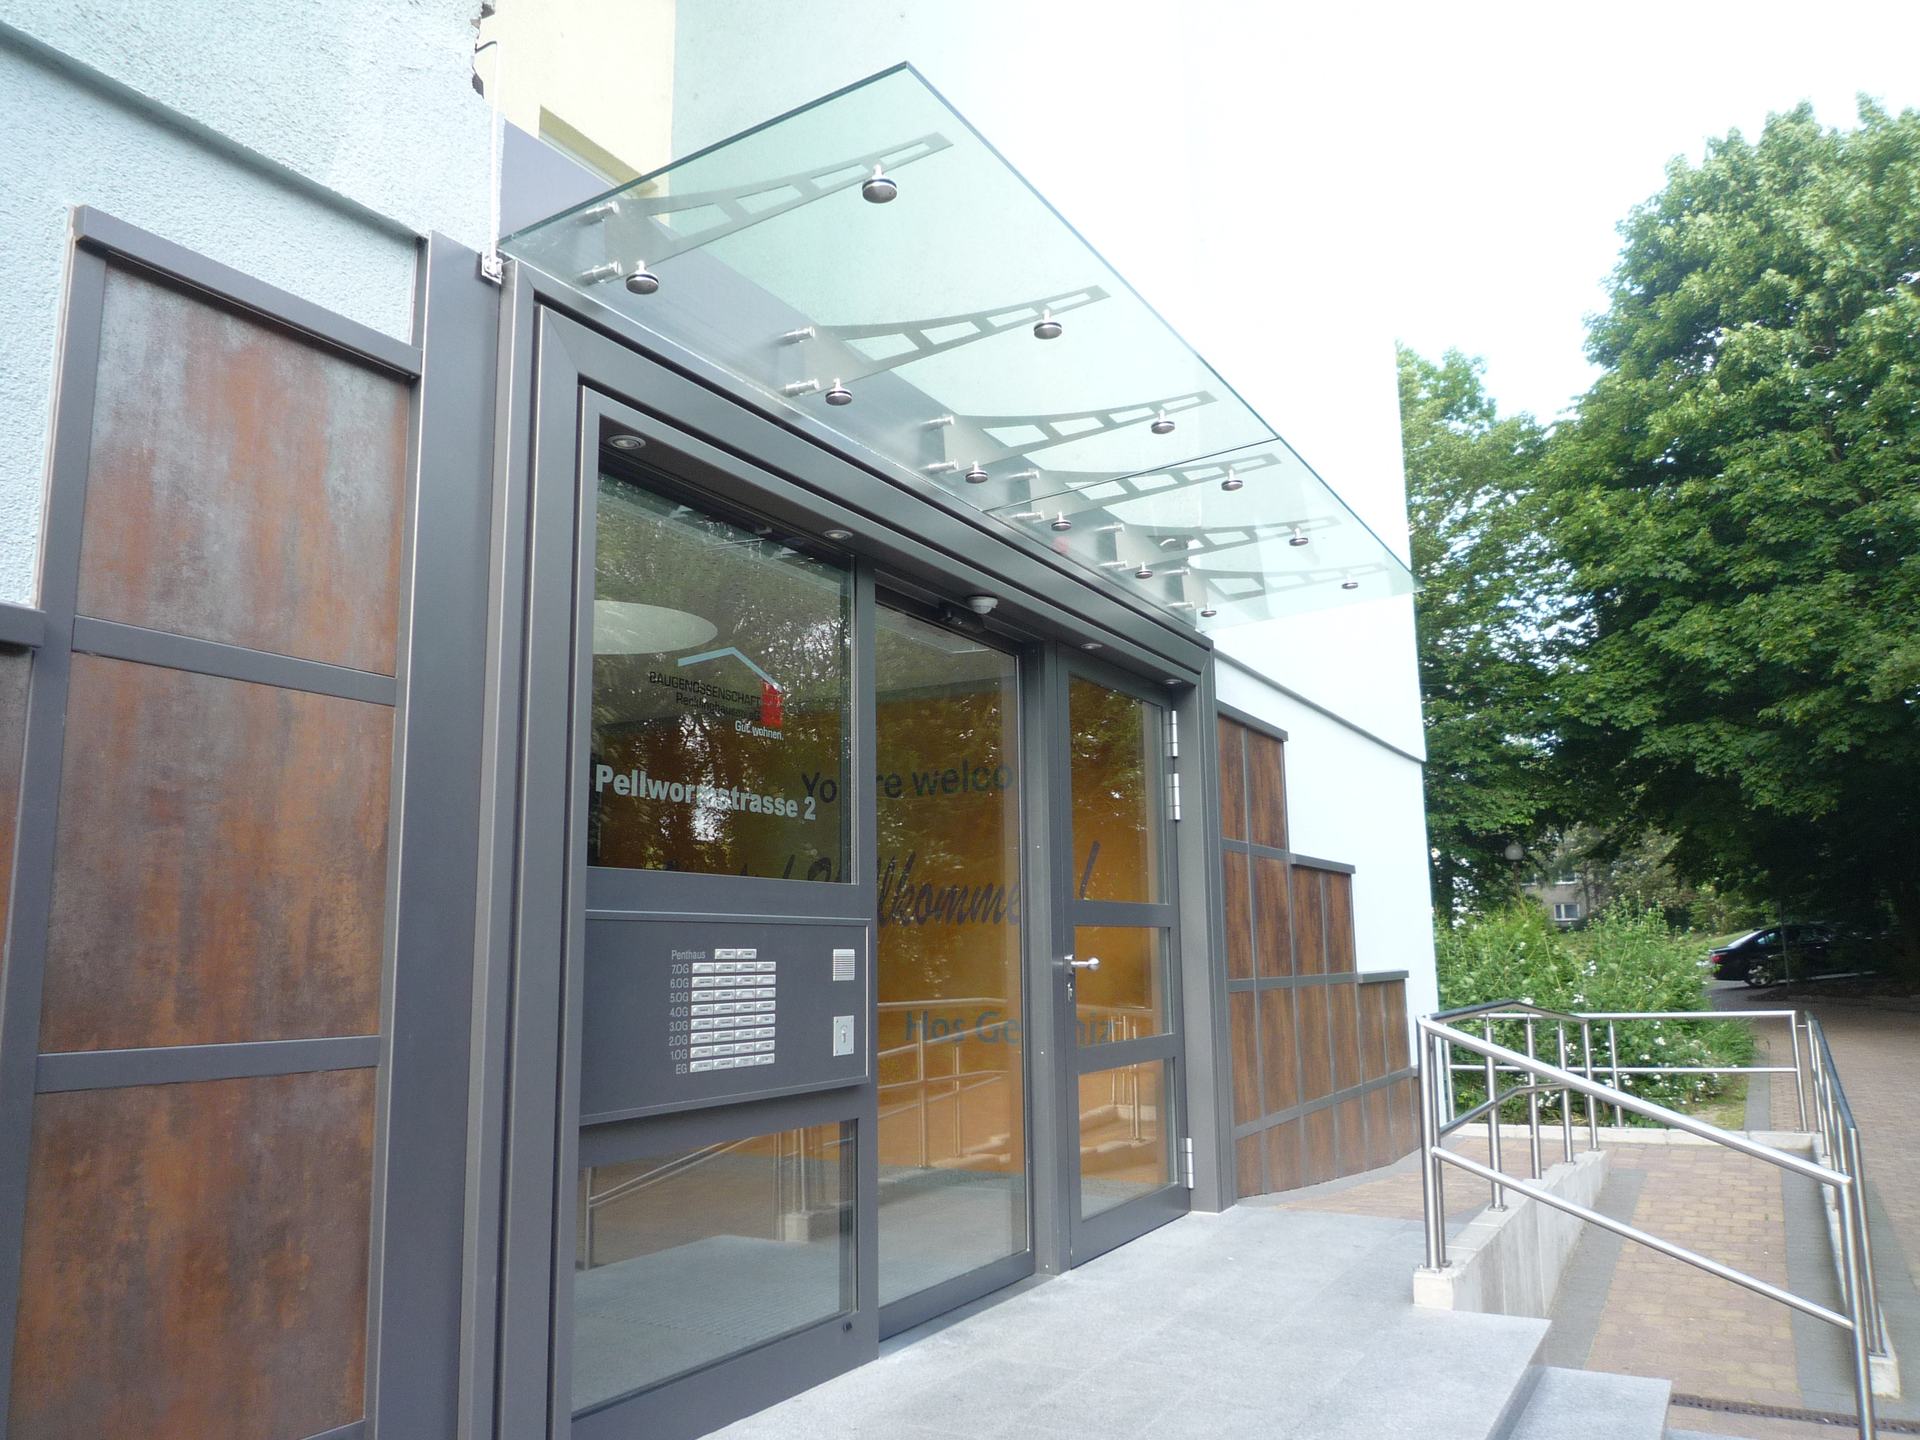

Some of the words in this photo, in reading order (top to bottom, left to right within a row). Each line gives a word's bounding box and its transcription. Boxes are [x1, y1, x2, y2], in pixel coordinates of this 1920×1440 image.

[649, 671, 761, 706] BAUGENOSSENSCHAFT
[802, 772, 838, 804] Yo
[912, 759, 1014, 796] welco
[804, 796, 816, 820] 2
[675, 1064, 688, 1074] EG
